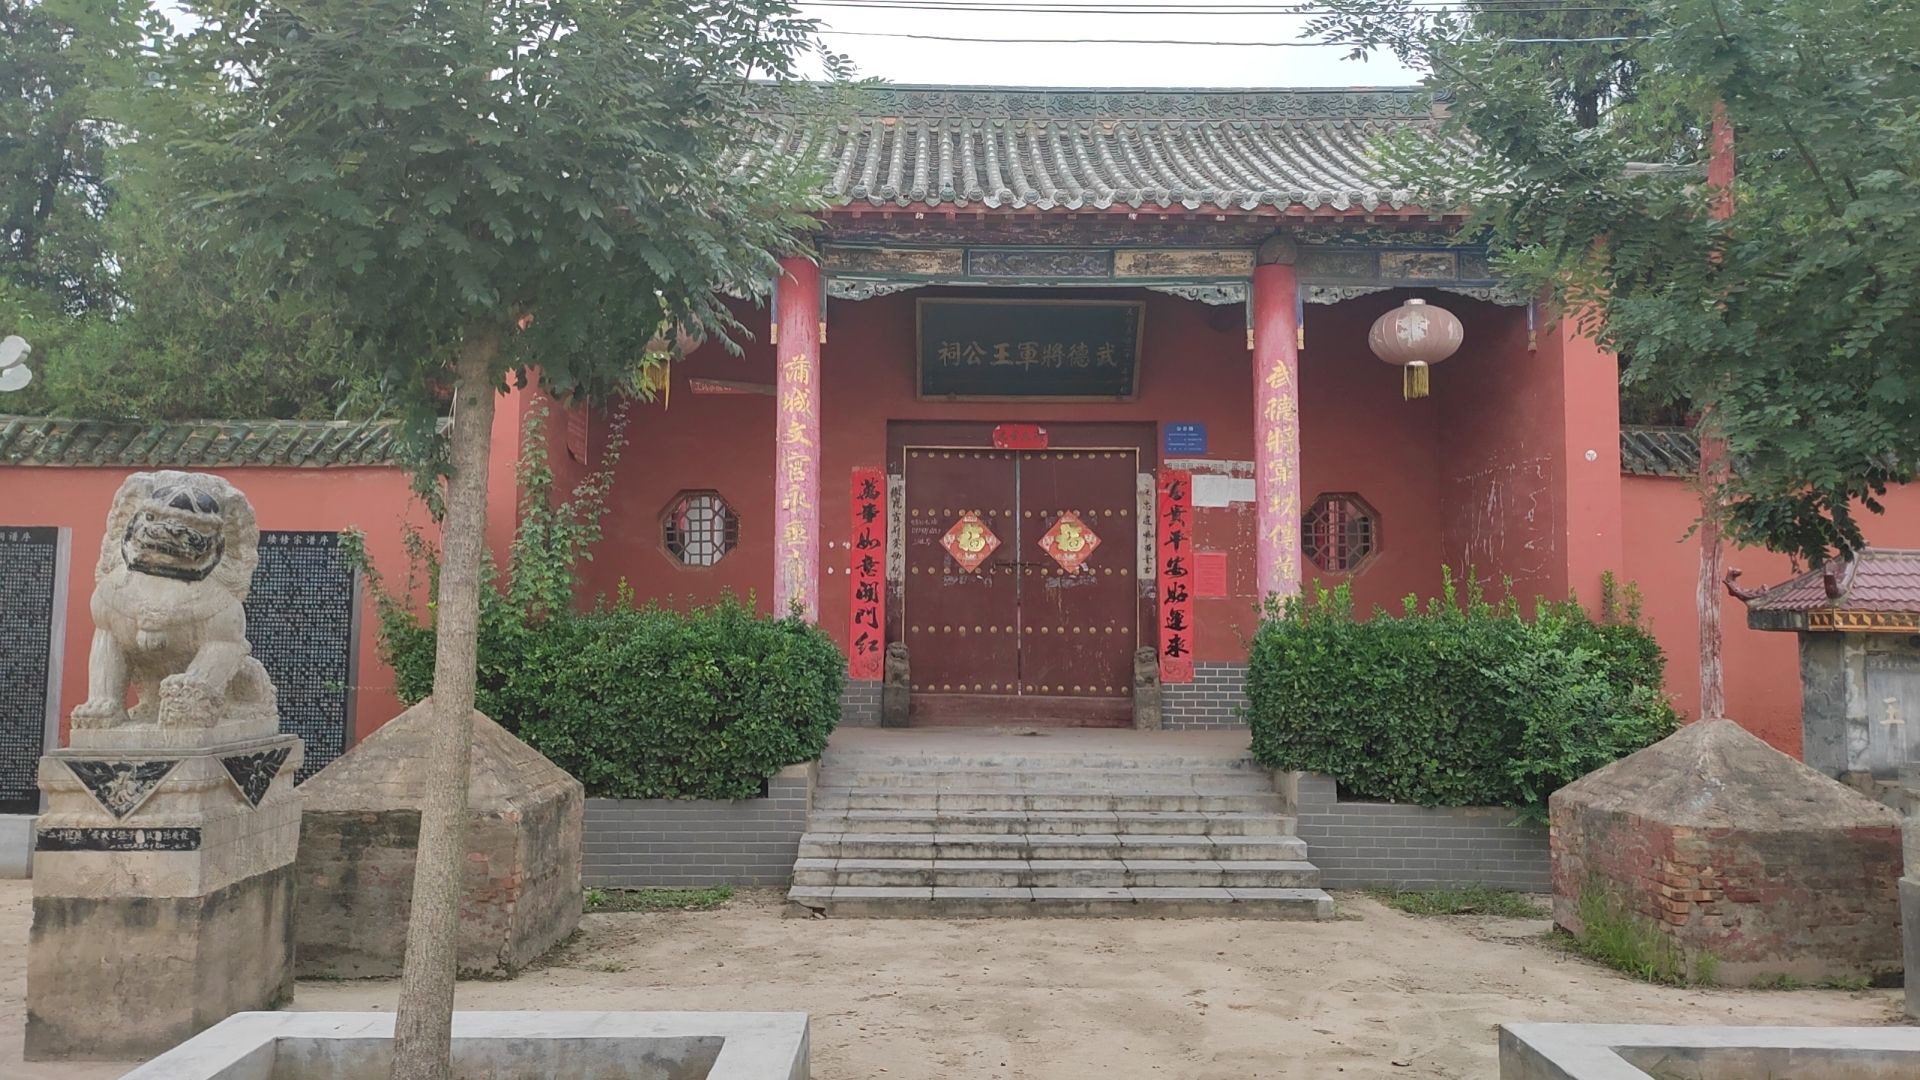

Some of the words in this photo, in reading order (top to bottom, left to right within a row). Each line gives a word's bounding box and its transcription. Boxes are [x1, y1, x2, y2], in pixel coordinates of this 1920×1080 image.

[938, 341, 1117, 372] 武德將軍王公祠
